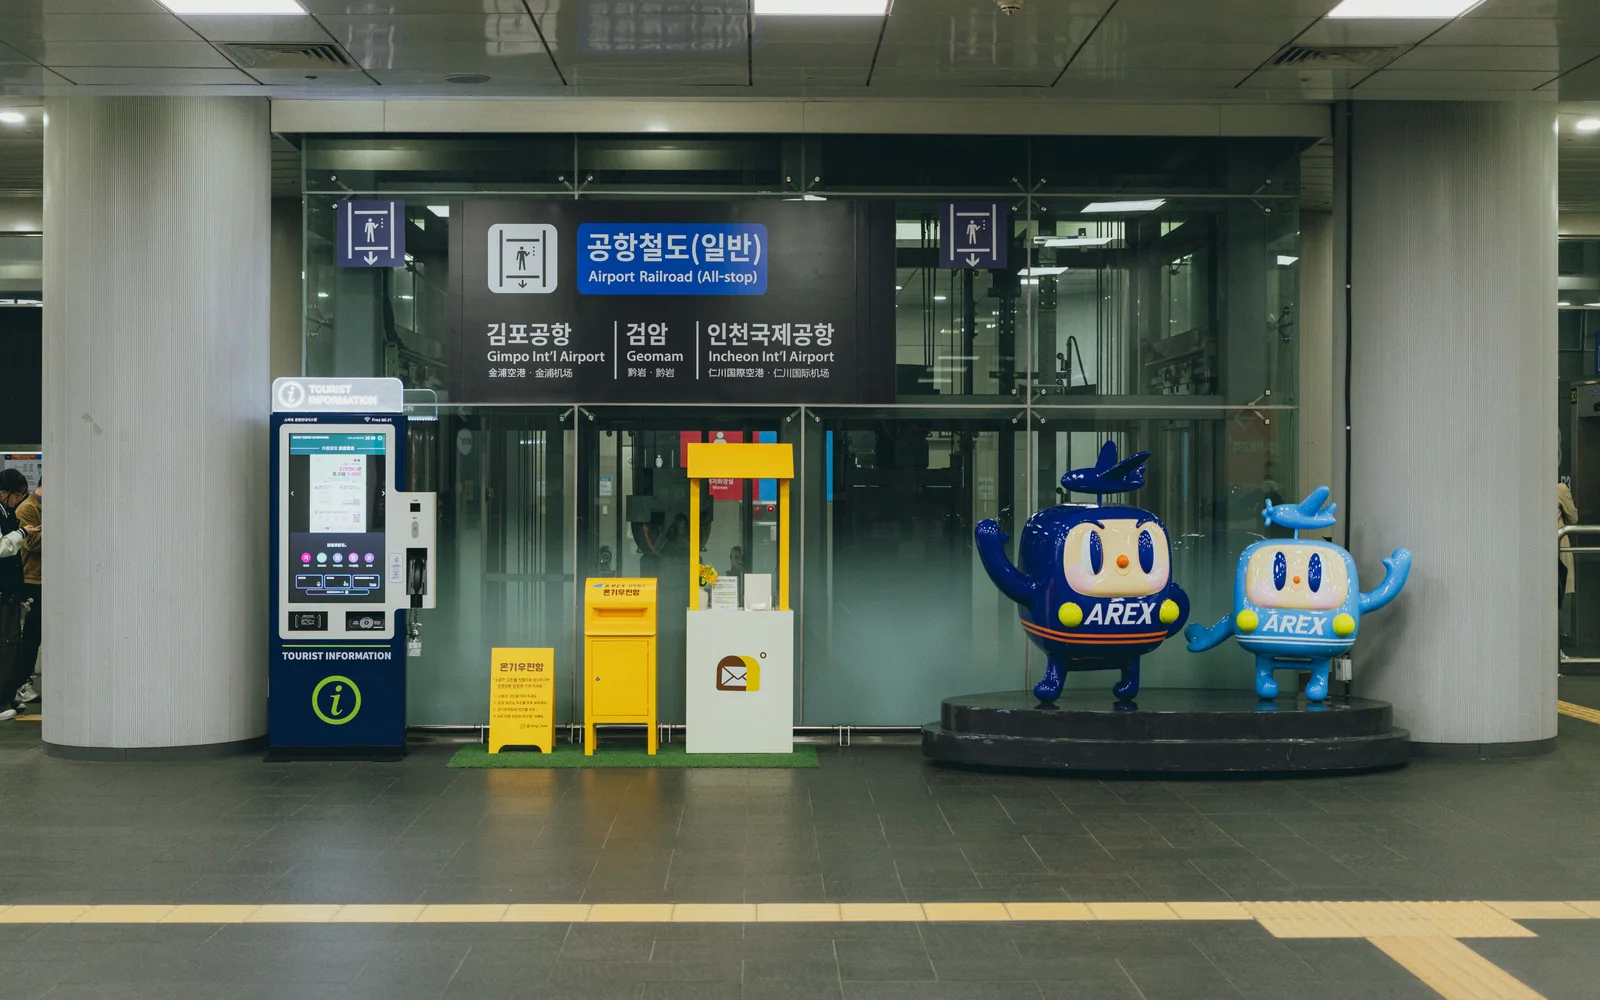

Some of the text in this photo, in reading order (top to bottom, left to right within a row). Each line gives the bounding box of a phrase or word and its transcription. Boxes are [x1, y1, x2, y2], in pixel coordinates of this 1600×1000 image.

[587, 232, 762, 266] 공항철도(일반)
[588, 270, 758, 286] Airport Railroad (All-stop)
[487, 322, 572, 347] 김포공항
[626, 322, 669, 346] 검암
[707, 322, 835, 347] 인천국제공항
[487, 350, 605, 365] Gimpo Int'l Airport
[626, 350, 684, 362] Geomam
[708, 350, 835, 365] Incheon Int'l Airport
[309, 384, 352, 394] TOURIST
[308, 395, 378, 405] INFORMATION
[603, 588, 640, 597] 온기우편함
[1084, 602, 1156, 626] AREX
[1262, 614, 1328, 637] AREX
[282, 651, 392, 661] TOURIST INFORMATION
[499, 662, 545, 673] 온기우편함
